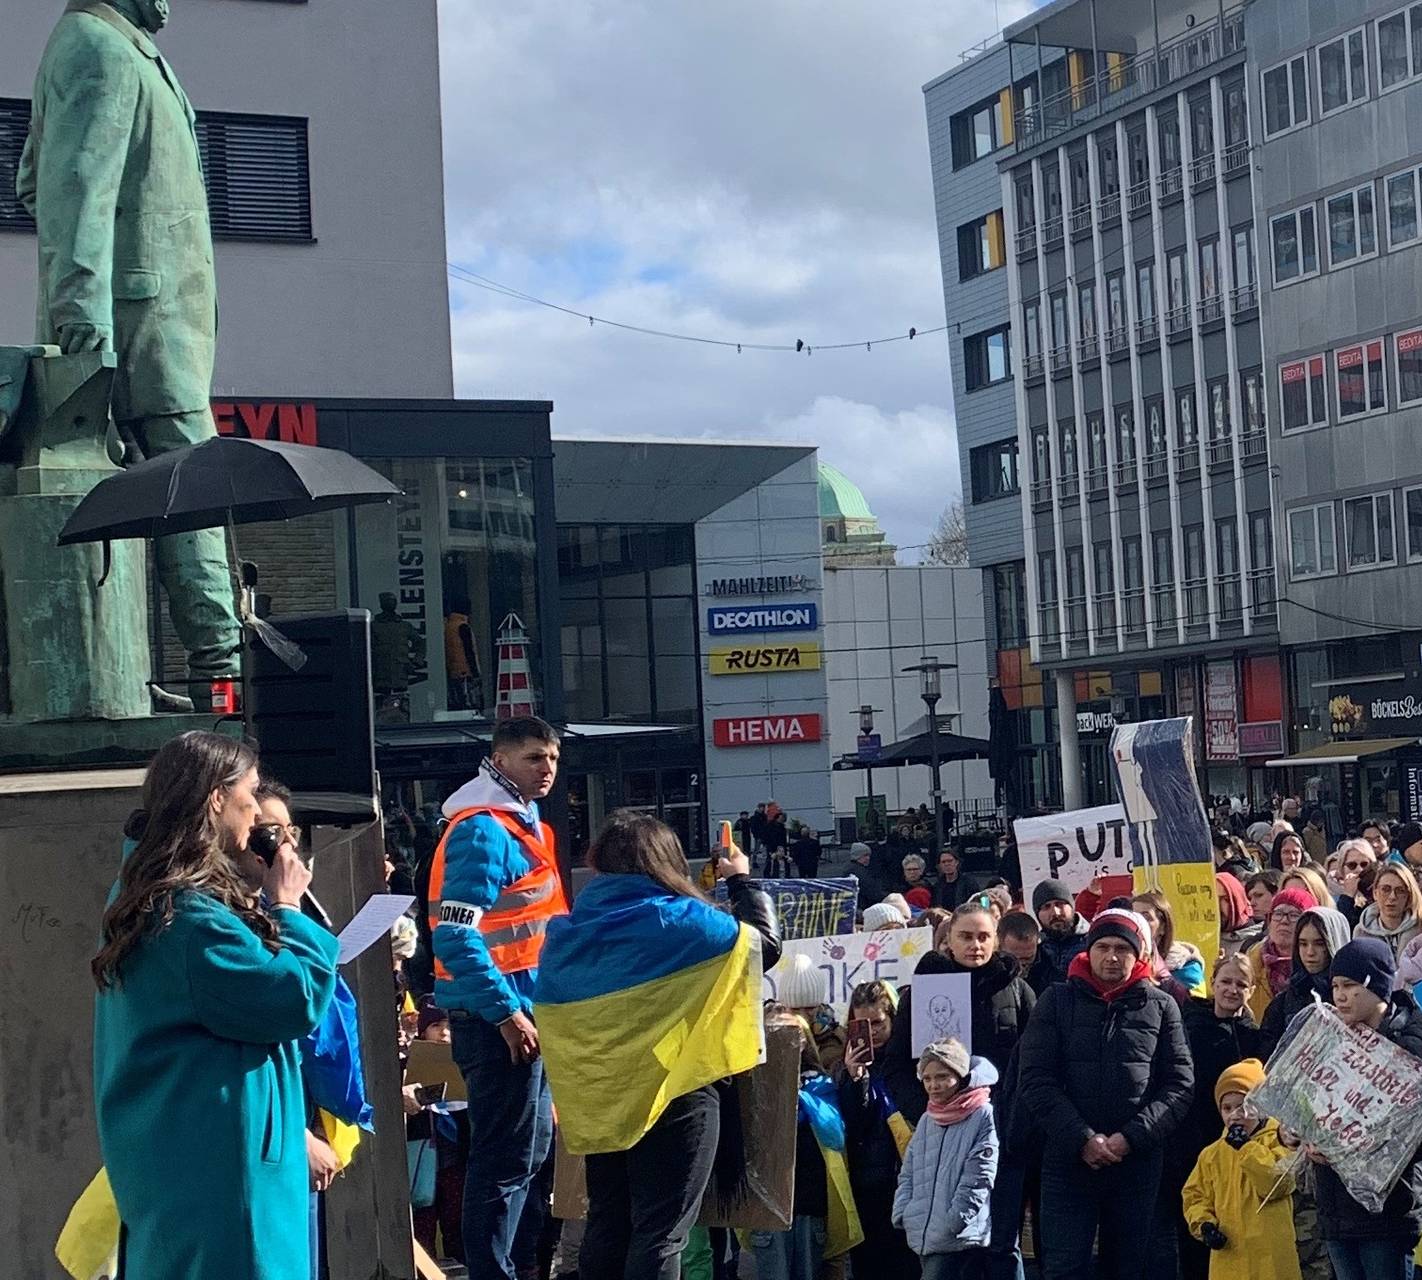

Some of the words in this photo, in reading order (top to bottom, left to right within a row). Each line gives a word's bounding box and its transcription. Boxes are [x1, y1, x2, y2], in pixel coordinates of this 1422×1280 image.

[1339, 352, 1363, 367] BEDITA
[1282, 367, 1306, 382] BEDITA
[712, 576, 794, 596] MAHLZEIT!
[713, 609, 811, 629] DECATHLON
[726, 647, 801, 669] RUSTA
[728, 718, 805, 743] HEMA
[690, 774, 699, 787] 2
[1408, 767, 1419, 822] informati
[1047, 819, 1126, 879] PUT
[777, 890, 854, 941] RAINE
